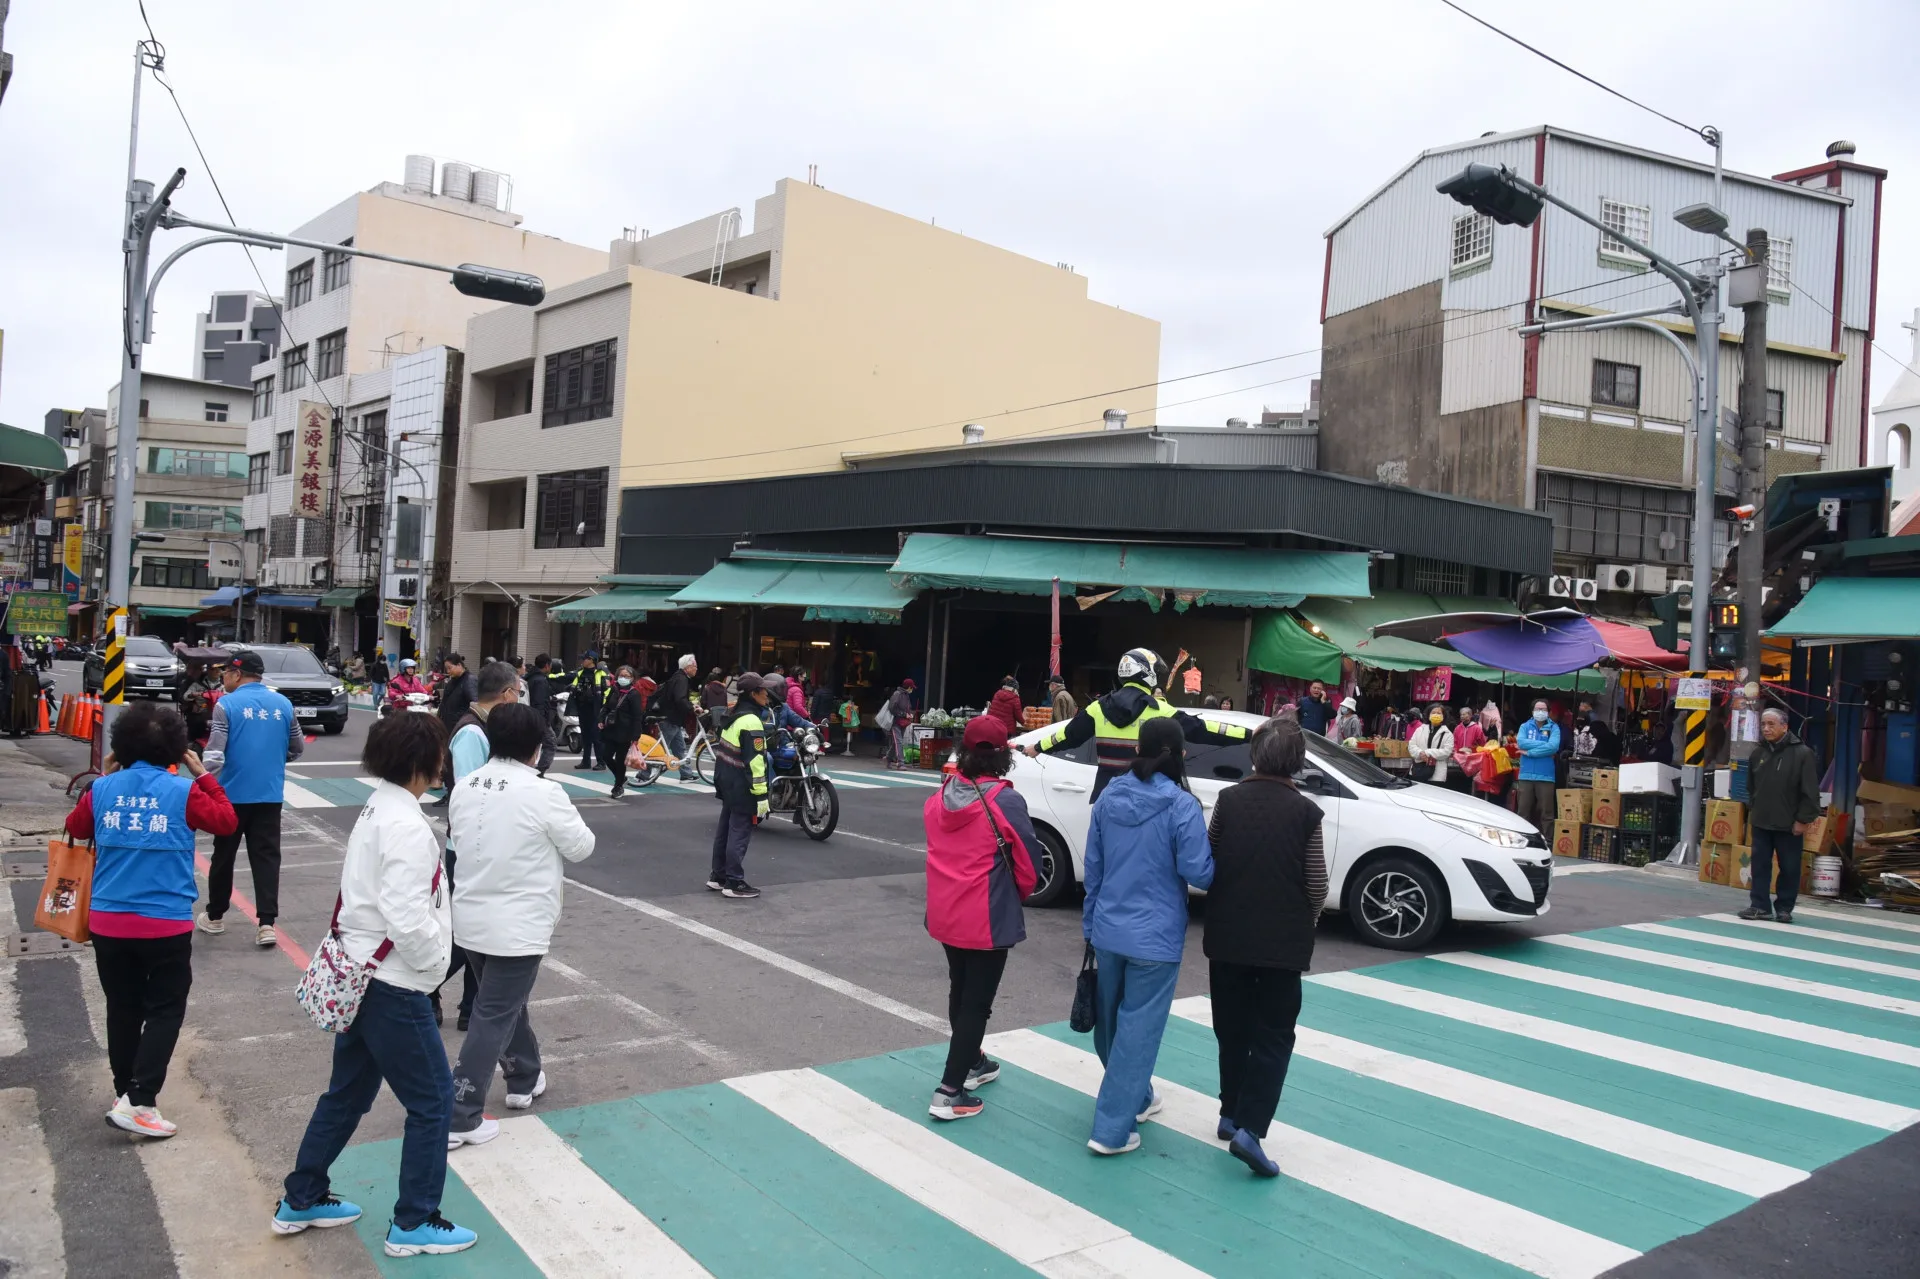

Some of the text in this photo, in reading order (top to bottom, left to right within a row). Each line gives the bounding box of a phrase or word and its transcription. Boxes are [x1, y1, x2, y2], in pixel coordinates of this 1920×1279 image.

[300, 408, 327, 512] 金源美銀樓
[1721, 604, 1739, 625] 17
[115, 795, 159, 810] 玉清里長
